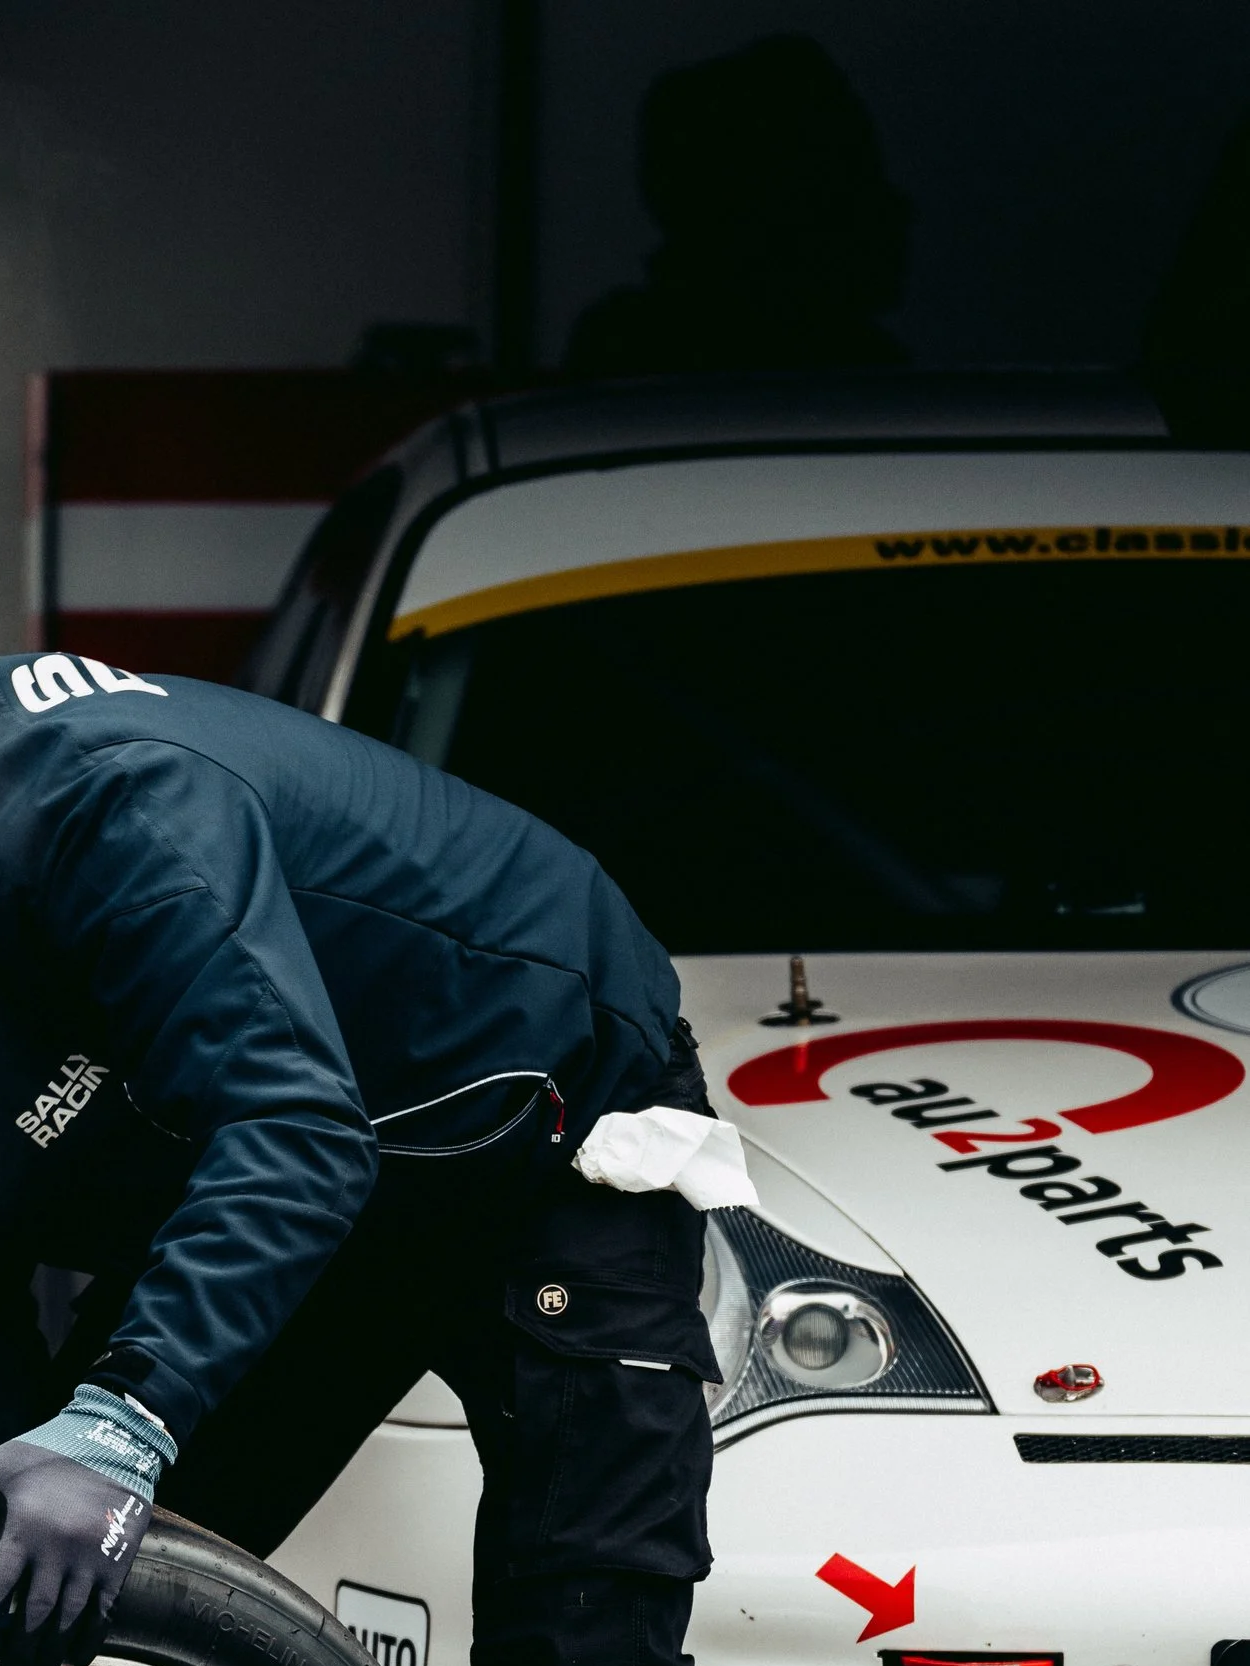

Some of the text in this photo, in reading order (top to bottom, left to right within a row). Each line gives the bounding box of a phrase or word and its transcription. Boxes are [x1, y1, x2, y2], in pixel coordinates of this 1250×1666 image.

[873, 526, 1250, 560] www.classi
[15, 1053, 90, 1134] SALLY
[849, 1077, 1224, 1282] au2parts
[542, 1290, 563, 1309] FE
